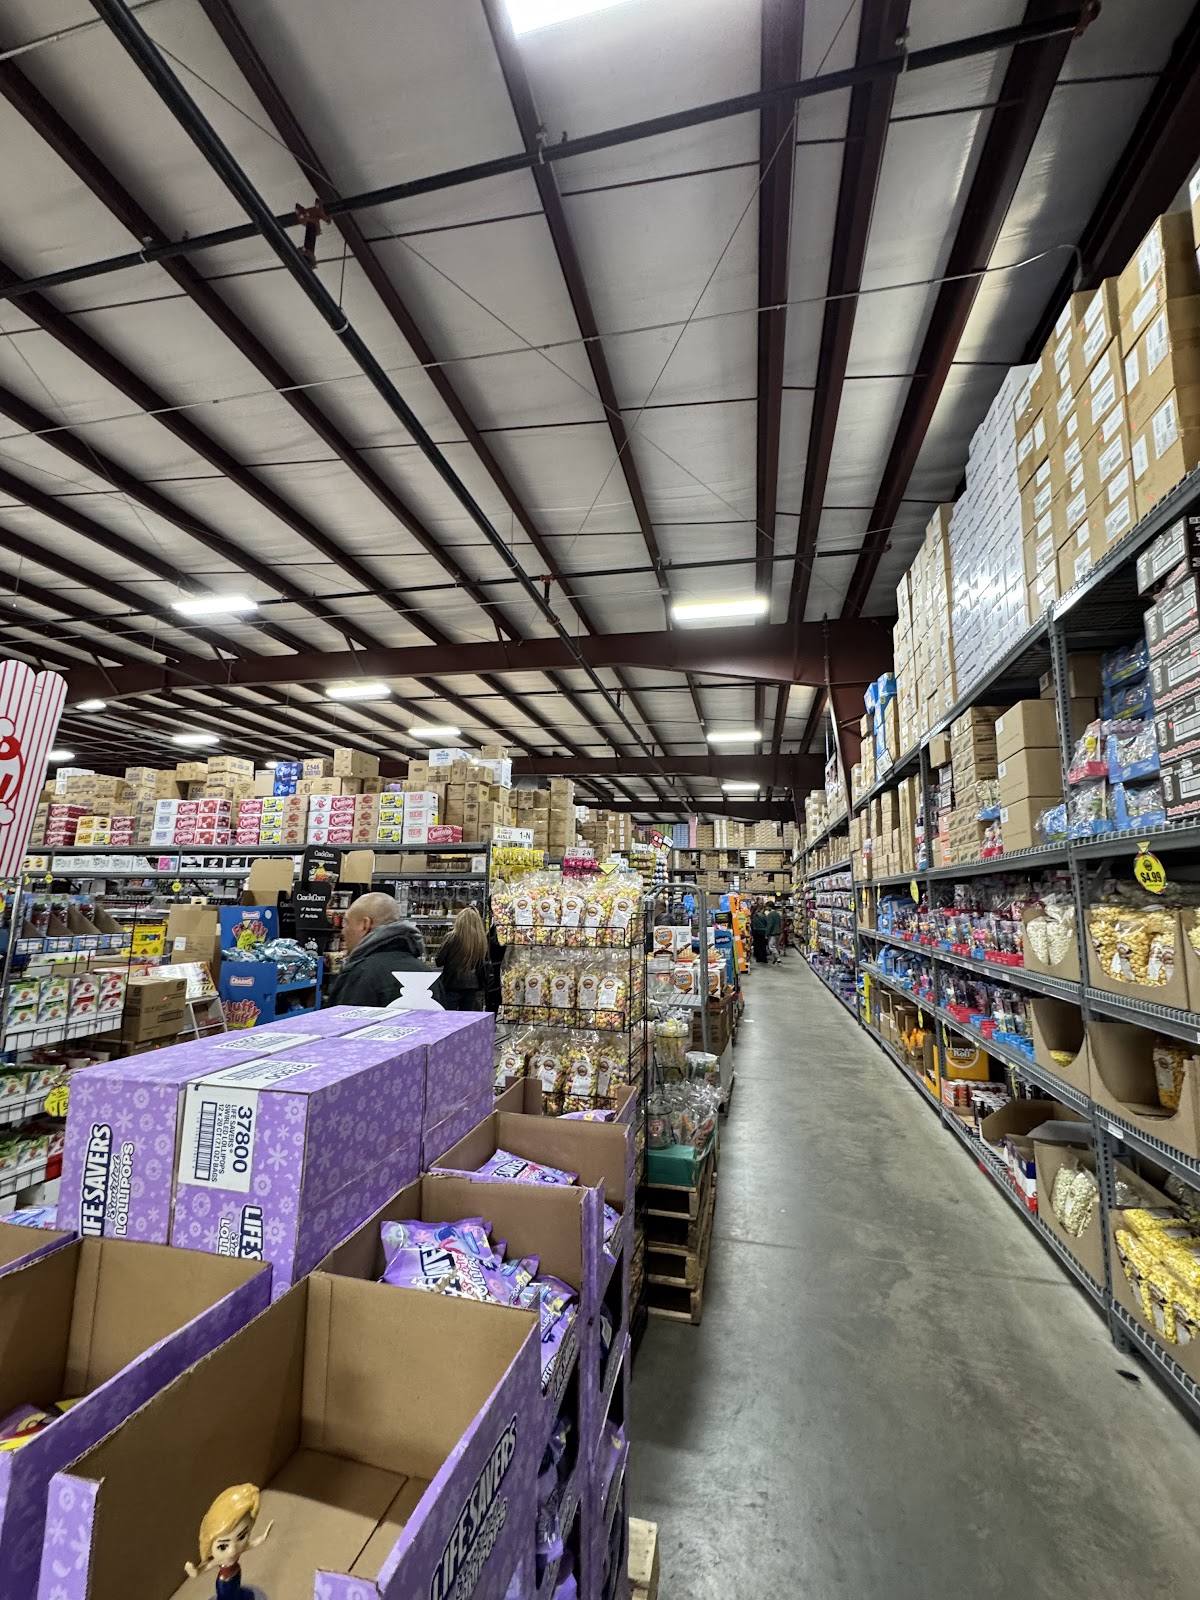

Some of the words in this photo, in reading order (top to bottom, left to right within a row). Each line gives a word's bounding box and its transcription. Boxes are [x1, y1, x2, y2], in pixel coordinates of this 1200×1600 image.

[519, 831, 531, 840] 1-N
[1140, 871, 1162, 883] $4.99
[218, 1104, 225, 1112] 12
[222, 1103, 231, 1136] SWIRLED
[215, 1127, 223, 1137] CT
[216, 1118, 224, 1127] 20
[227, 1121, 237, 1148] SAVERS
[232, 1106, 253, 1174] 37800
[218, 1136, 228, 1175] LOLLIPOPS
[82, 1123, 113, 1236] IFESAVERS
[211, 1162, 219, 1182] BAGS
[115, 1142, 135, 1236] LOLLIPOPS
[240, 1206, 263, 1261] LIFES
